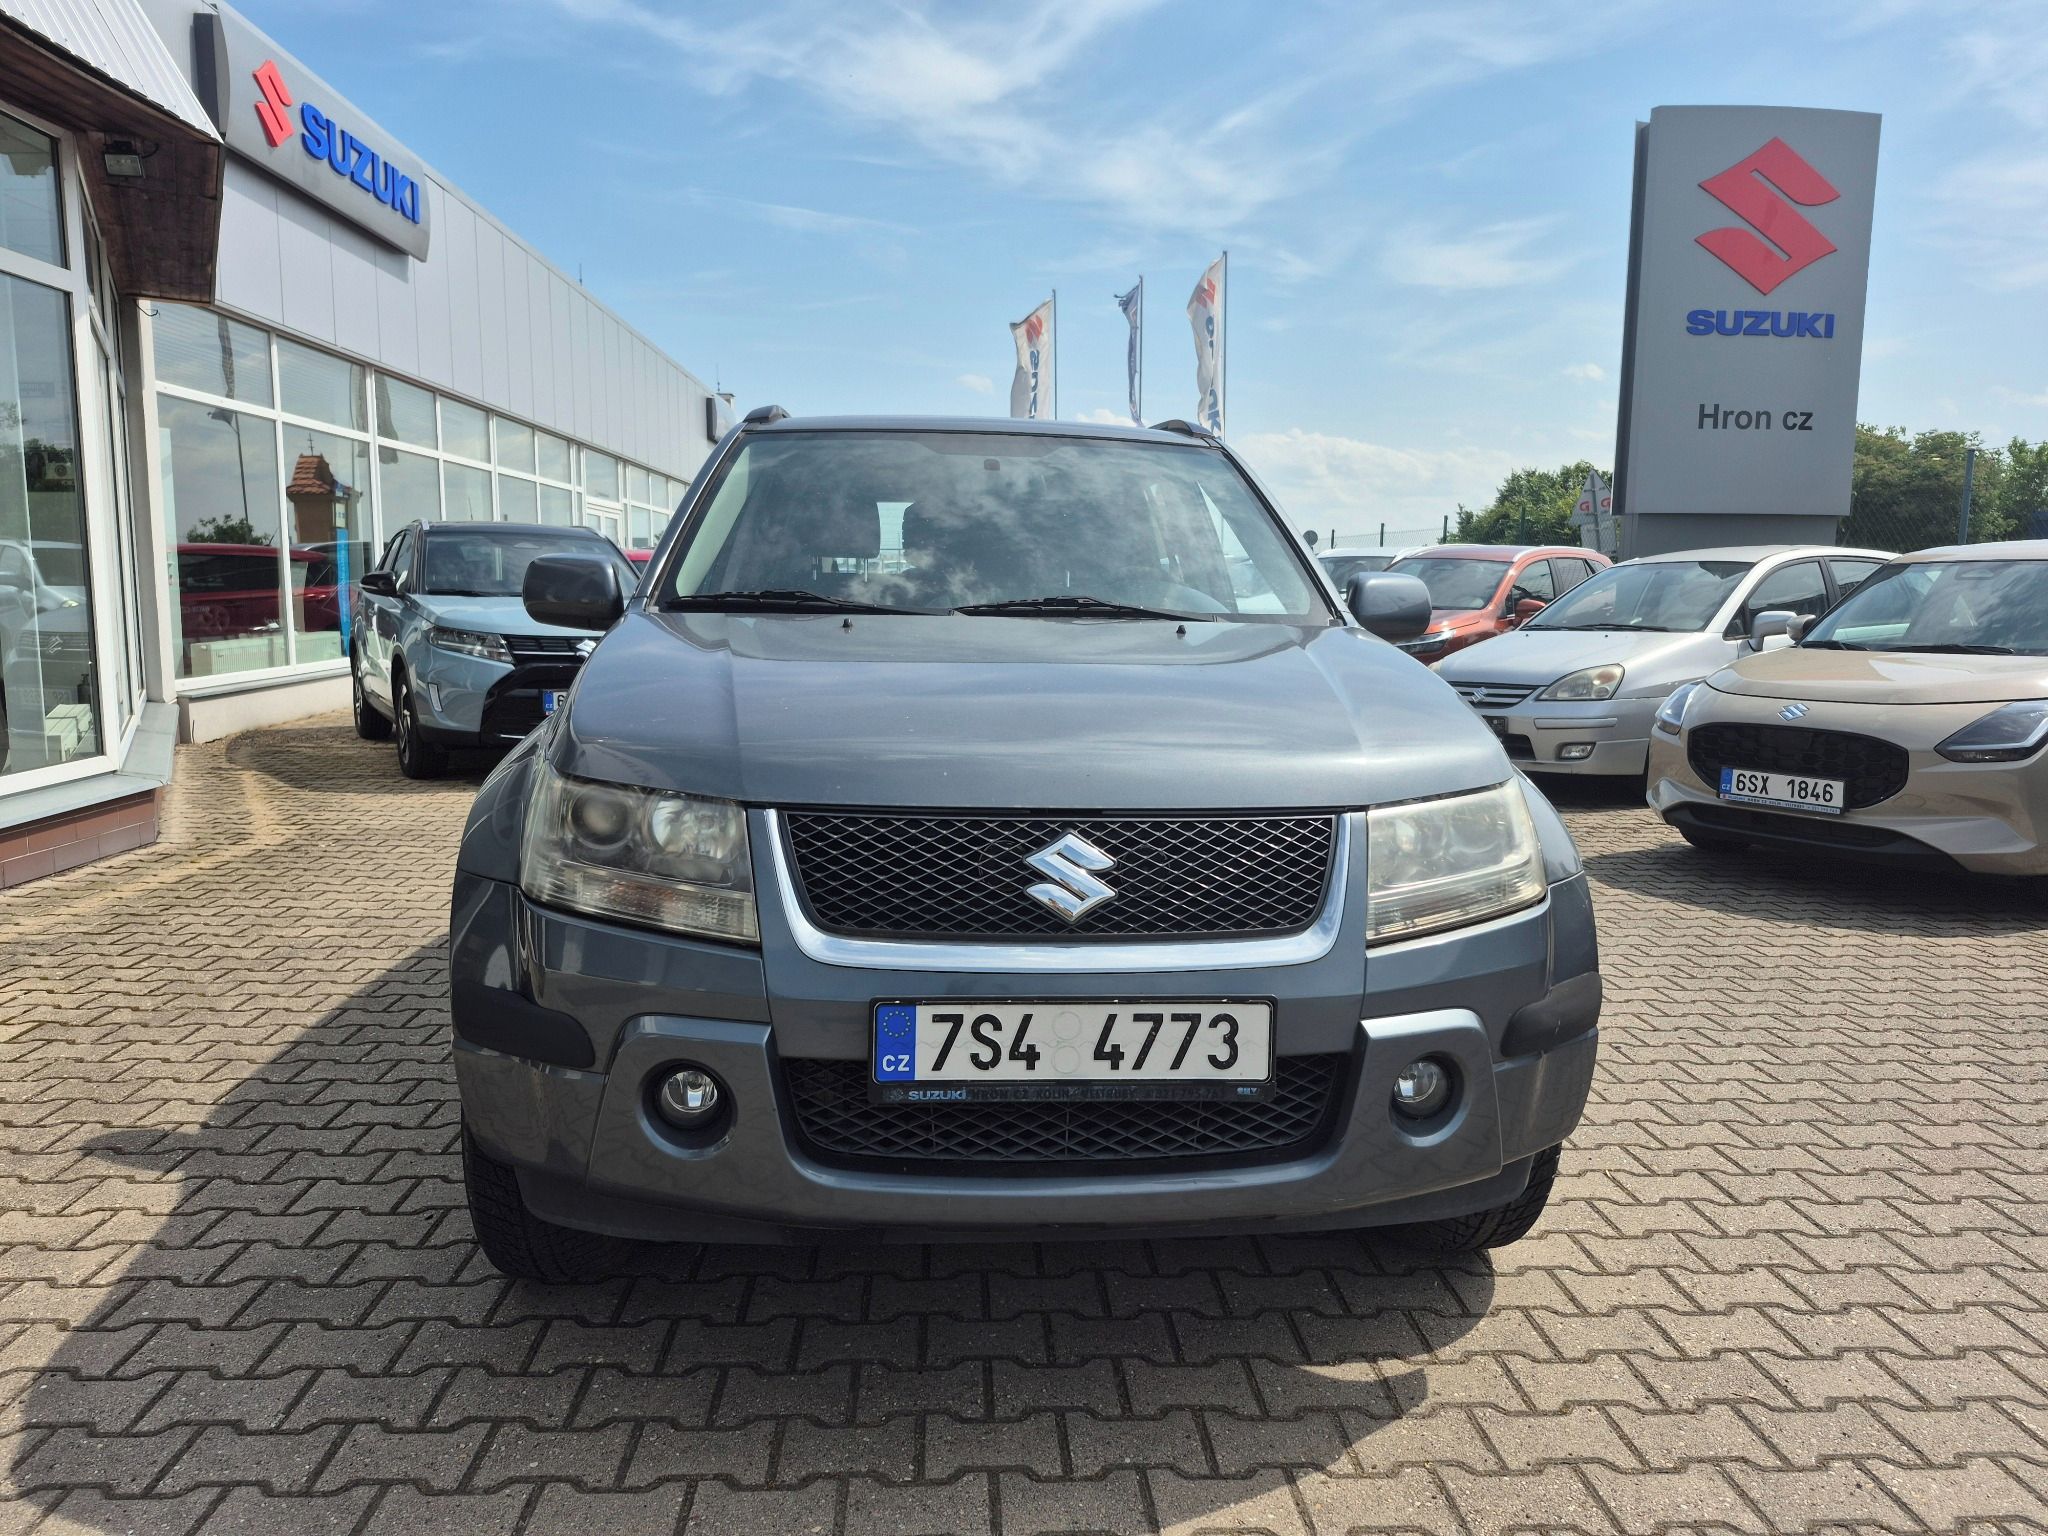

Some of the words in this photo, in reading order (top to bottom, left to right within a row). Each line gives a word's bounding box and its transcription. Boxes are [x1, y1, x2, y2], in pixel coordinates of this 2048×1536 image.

[301, 103, 419, 224] SUZUKI
[1686, 309, 1835, 338] SUZUKI
[1697, 403, 1771, 430] Hron
[1782, 411, 1813, 430] cz
[1736, 773, 1769, 795] 6SX
[1787, 779, 1834, 802] 1846
[882, 1055, 910, 1071] CZ
[931, 1013, 1041, 1071] 7S4
[1093, 1013, 1239, 1070] 4773
[908, 1089, 966, 1100] SUZUKI
